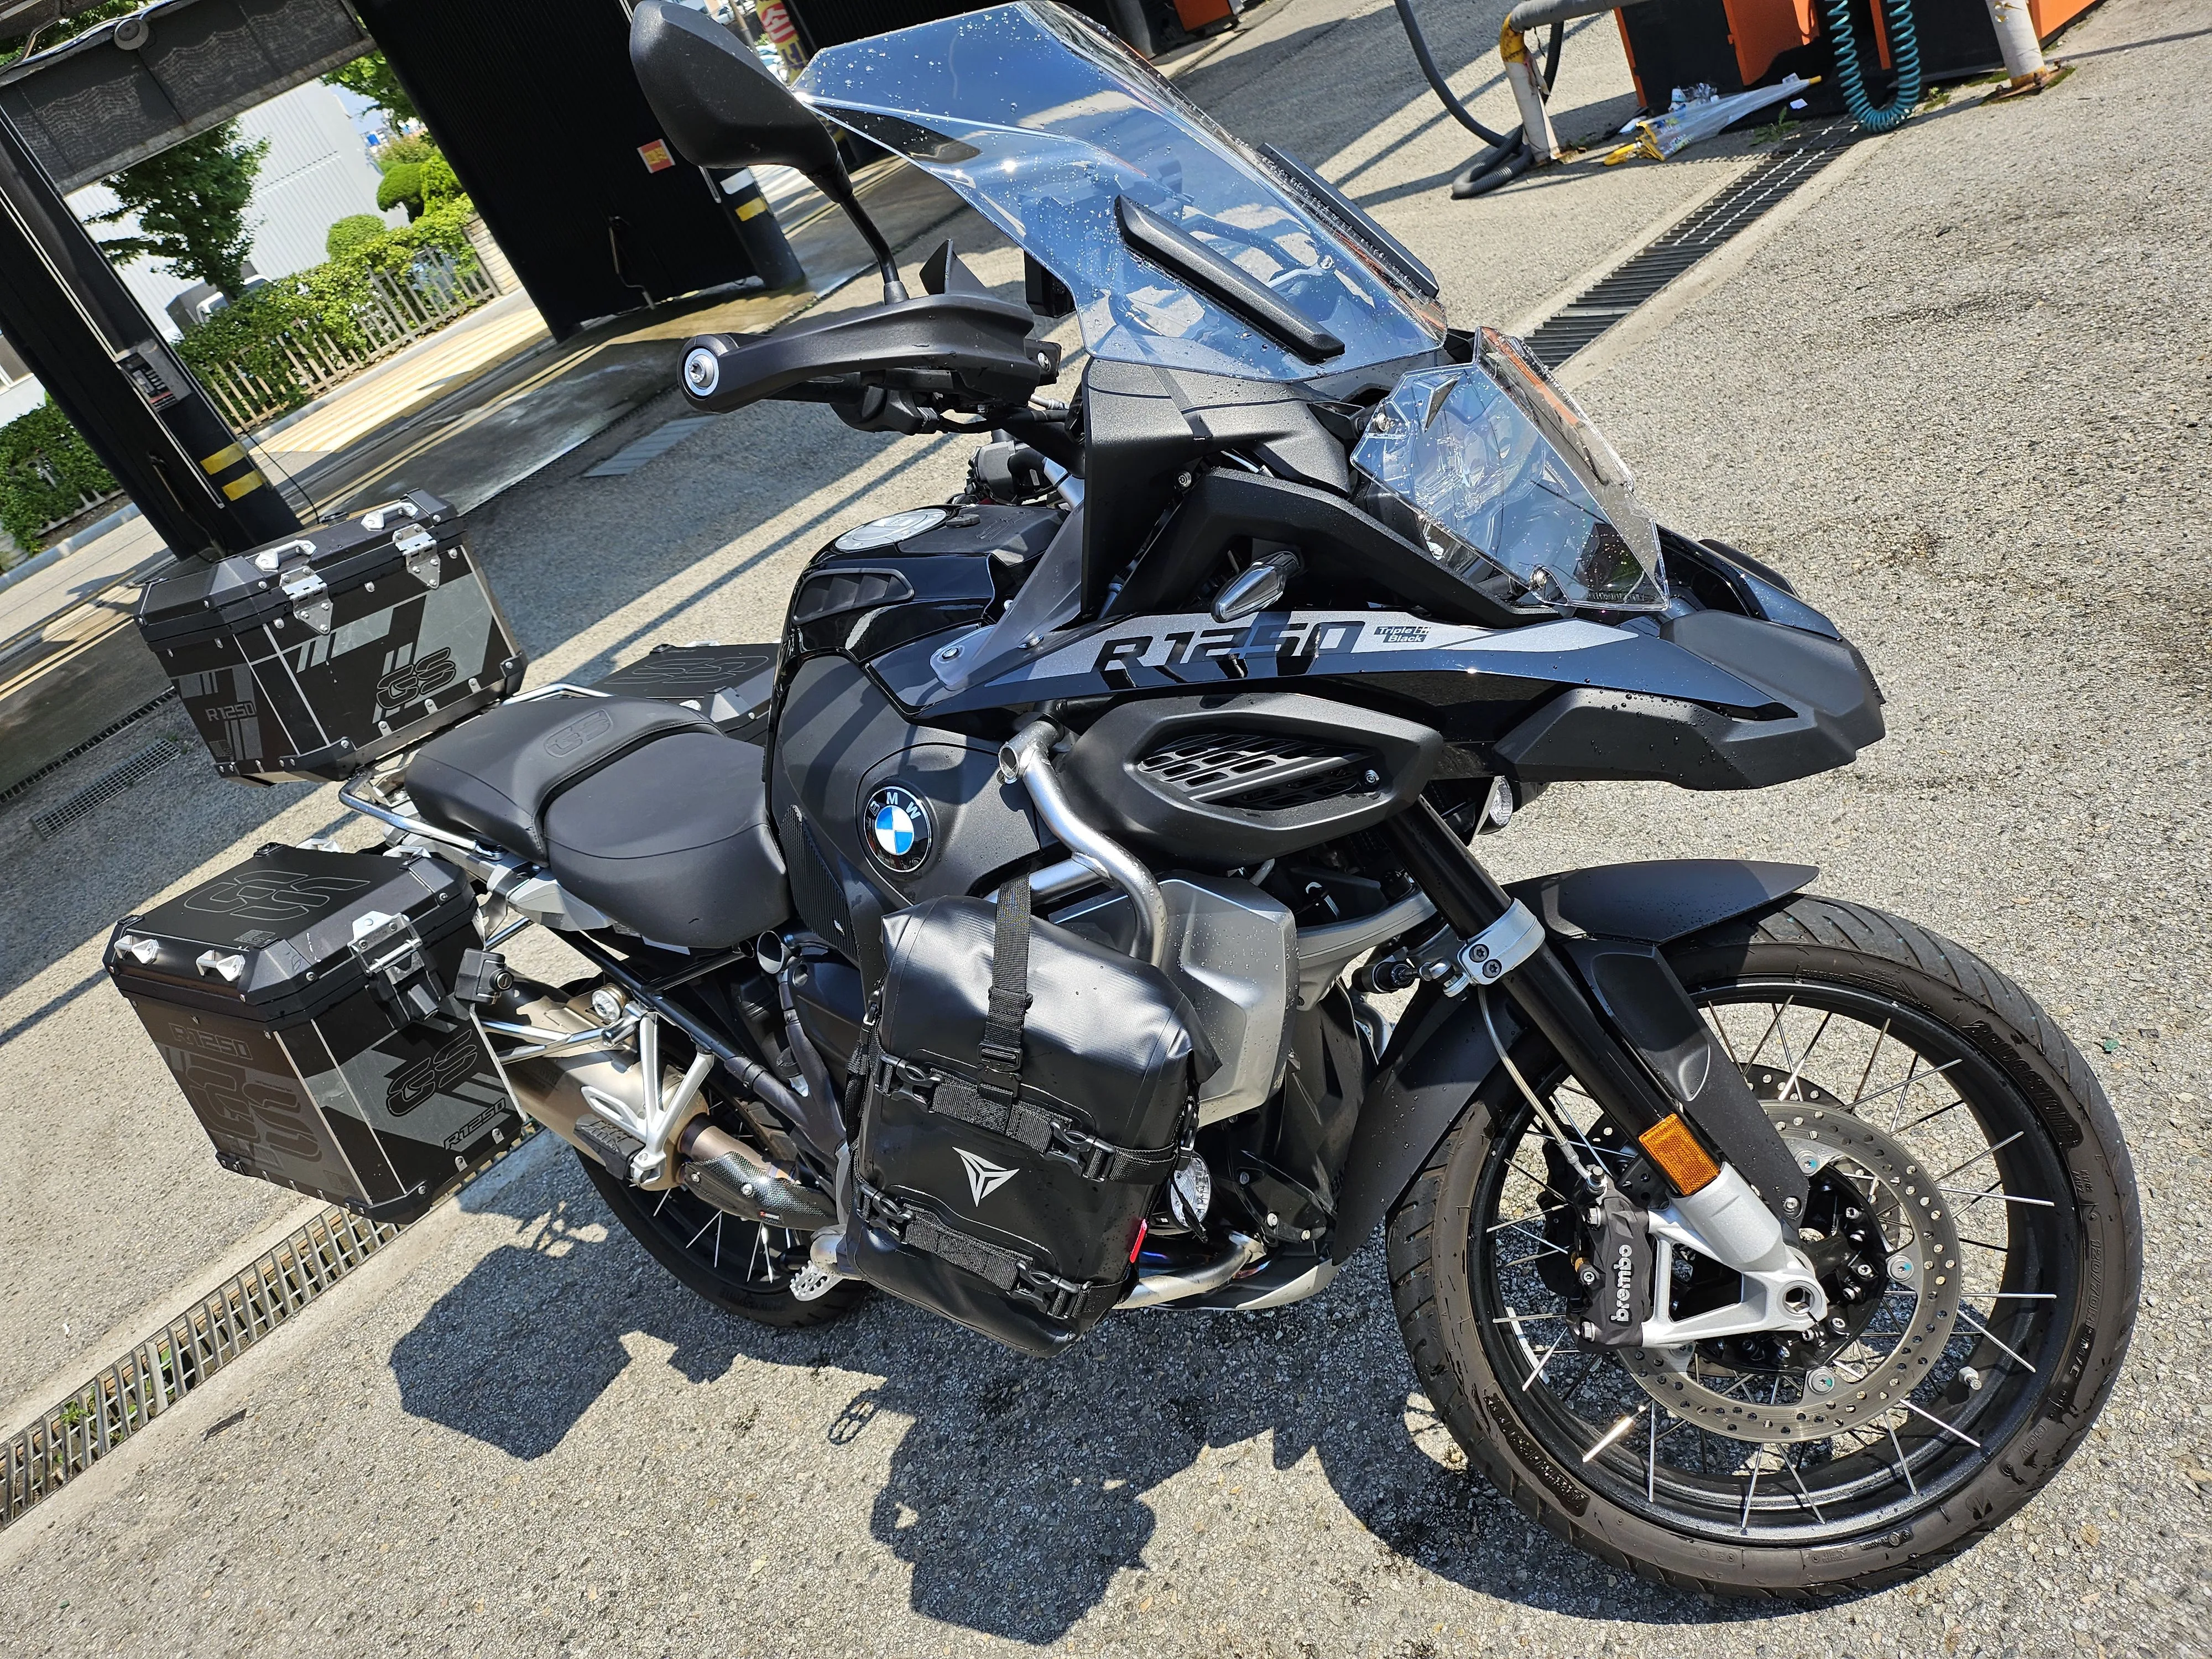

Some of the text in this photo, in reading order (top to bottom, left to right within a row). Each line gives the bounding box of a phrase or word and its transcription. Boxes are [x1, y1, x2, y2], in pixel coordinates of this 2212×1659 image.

[1092, 620, 1366, 672] R1250
[1379, 627, 1412, 635] Triple
[376, 646, 457, 709] GS
[205, 702, 255, 722] R1250
[869, 791, 921, 820] BMW
[168, 1022, 253, 1061] R1250
[386, 1029, 478, 1118] GS
[444, 1097, 507, 1145] R1250
[1610, 1244, 1632, 1322] brembo
